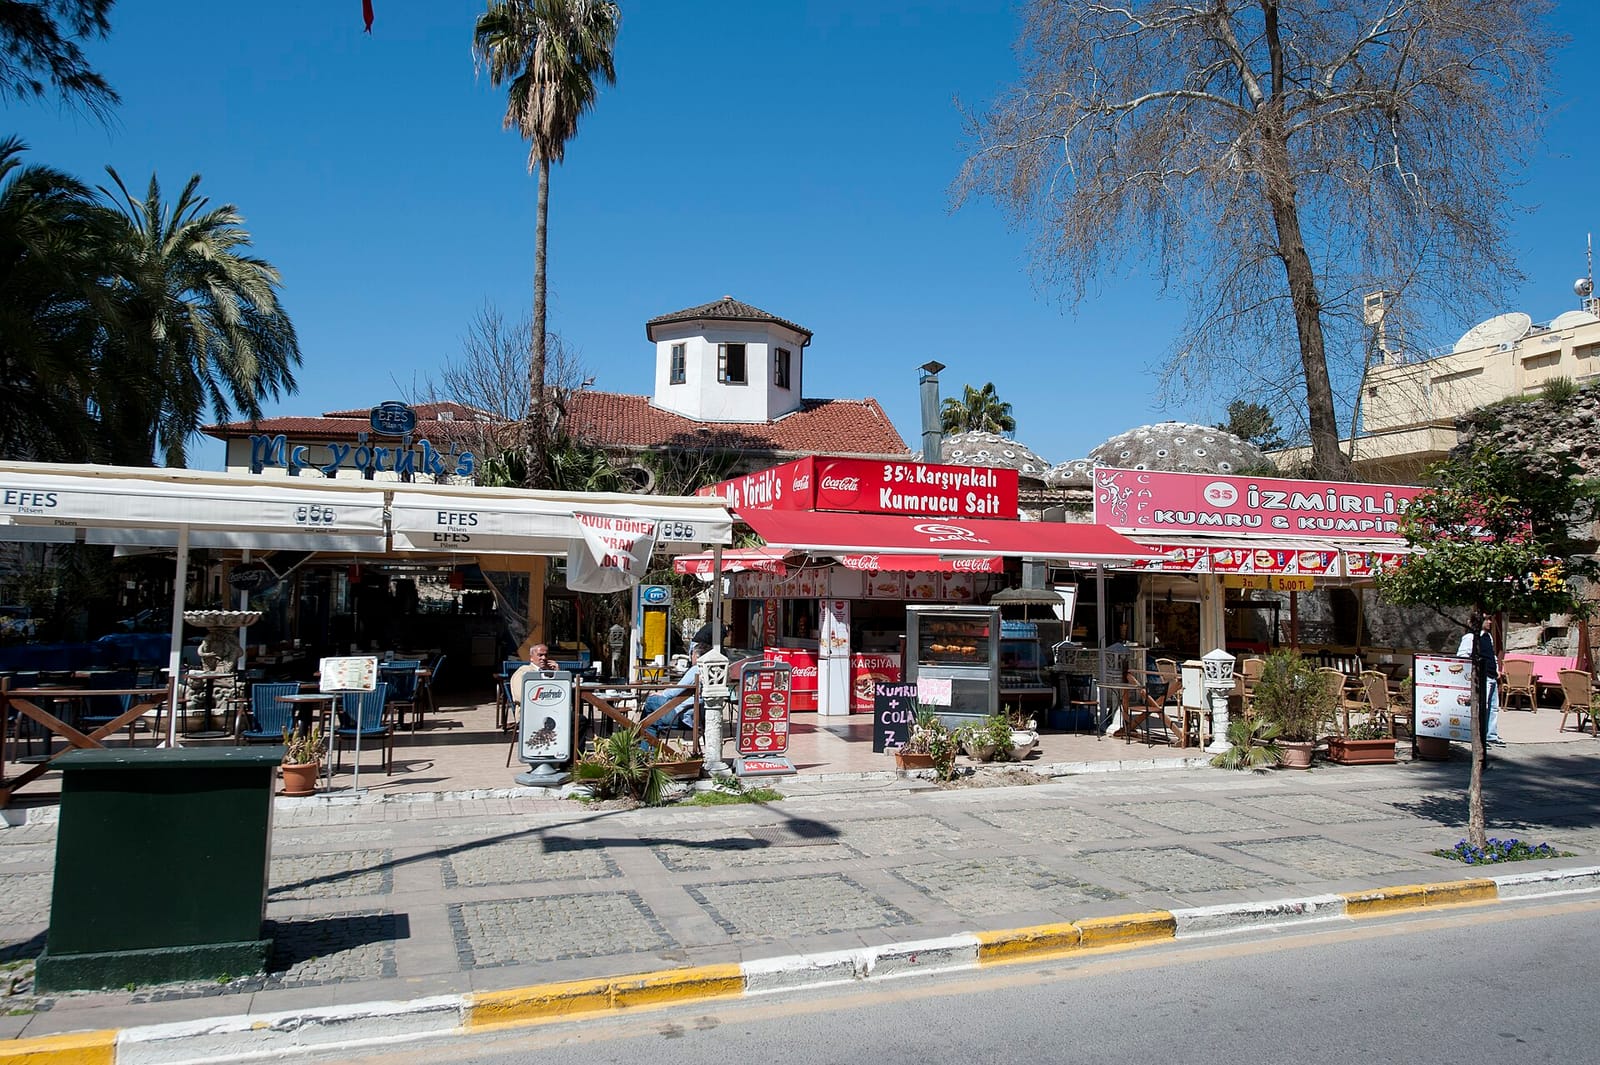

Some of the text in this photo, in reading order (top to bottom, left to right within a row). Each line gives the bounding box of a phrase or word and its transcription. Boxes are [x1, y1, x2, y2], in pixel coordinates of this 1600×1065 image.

[379, 410, 408, 422] EFES
[249, 434, 309, 468] Mc
[821, 476, 860, 491] Coca-Cola
[916, 466, 997, 491] Karşıyakalı
[726, 469, 782, 508] Mc Yörük's
[1209, 489, 1233, 499] 35
[4, 490, 58, 508] EFES
[880, 487, 1000, 514] Kumrucu Sait
[18, 506, 44, 514] Pilsen
[437, 511, 478, 526] EFES
[1154, 510, 1399, 533] KUMRU & KUMPİR
[615, 517, 654, 536] DÖNER
[433, 532, 470, 543] EFES
[791, 666, 818, 678] Coca-Cola
[876, 684, 917, 697] KUMRU
[889, 700, 899, 709] +
[881, 710, 916, 725] COLA
[884, 730, 896, 747] 7
